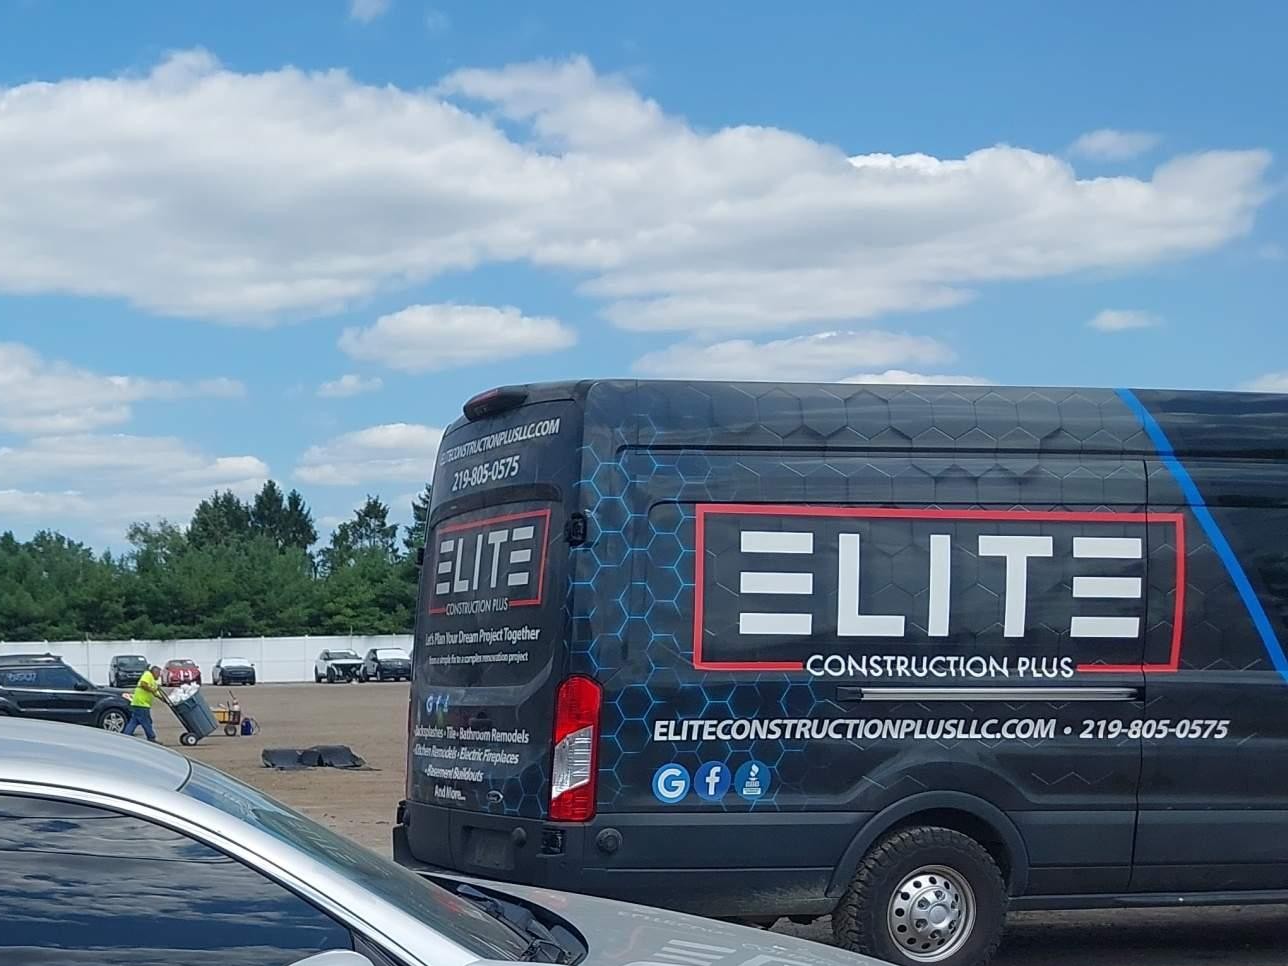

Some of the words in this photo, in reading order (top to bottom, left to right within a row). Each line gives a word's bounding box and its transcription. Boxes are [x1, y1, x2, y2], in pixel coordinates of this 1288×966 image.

[452, 455, 520, 492] 219-805-0575
[436, 526, 534, 594] ELITE
[739, 530, 1142, 638] ELITE
[446, 600, 492, 616] CONSTRUCTION
[492, 597, 508, 611] PLUS
[446, 631, 458, 645] Your
[458, 630, 479, 644] Dream
[479, 627, 503, 645] Project
[503, 625, 541, 645] Together
[508, 651, 529, 664] project
[806, 654, 1009, 678] CONSTRUCTION
[1016, 657, 1074, 678] PLUS
[459, 726, 491, 740] Bathroom
[492, 728, 530, 743] Remodels
[654, 718, 1057, 741] ELITECONSTRUCTIONPLUSLLC.COM
[1079, 719, 1230, 739] 219-805-0575
[459, 746, 483, 761] Electric
[482, 748, 519, 766] Fireplaces
[453, 766, 484, 782] Buildouts
[434, 784, 446, 798] And
